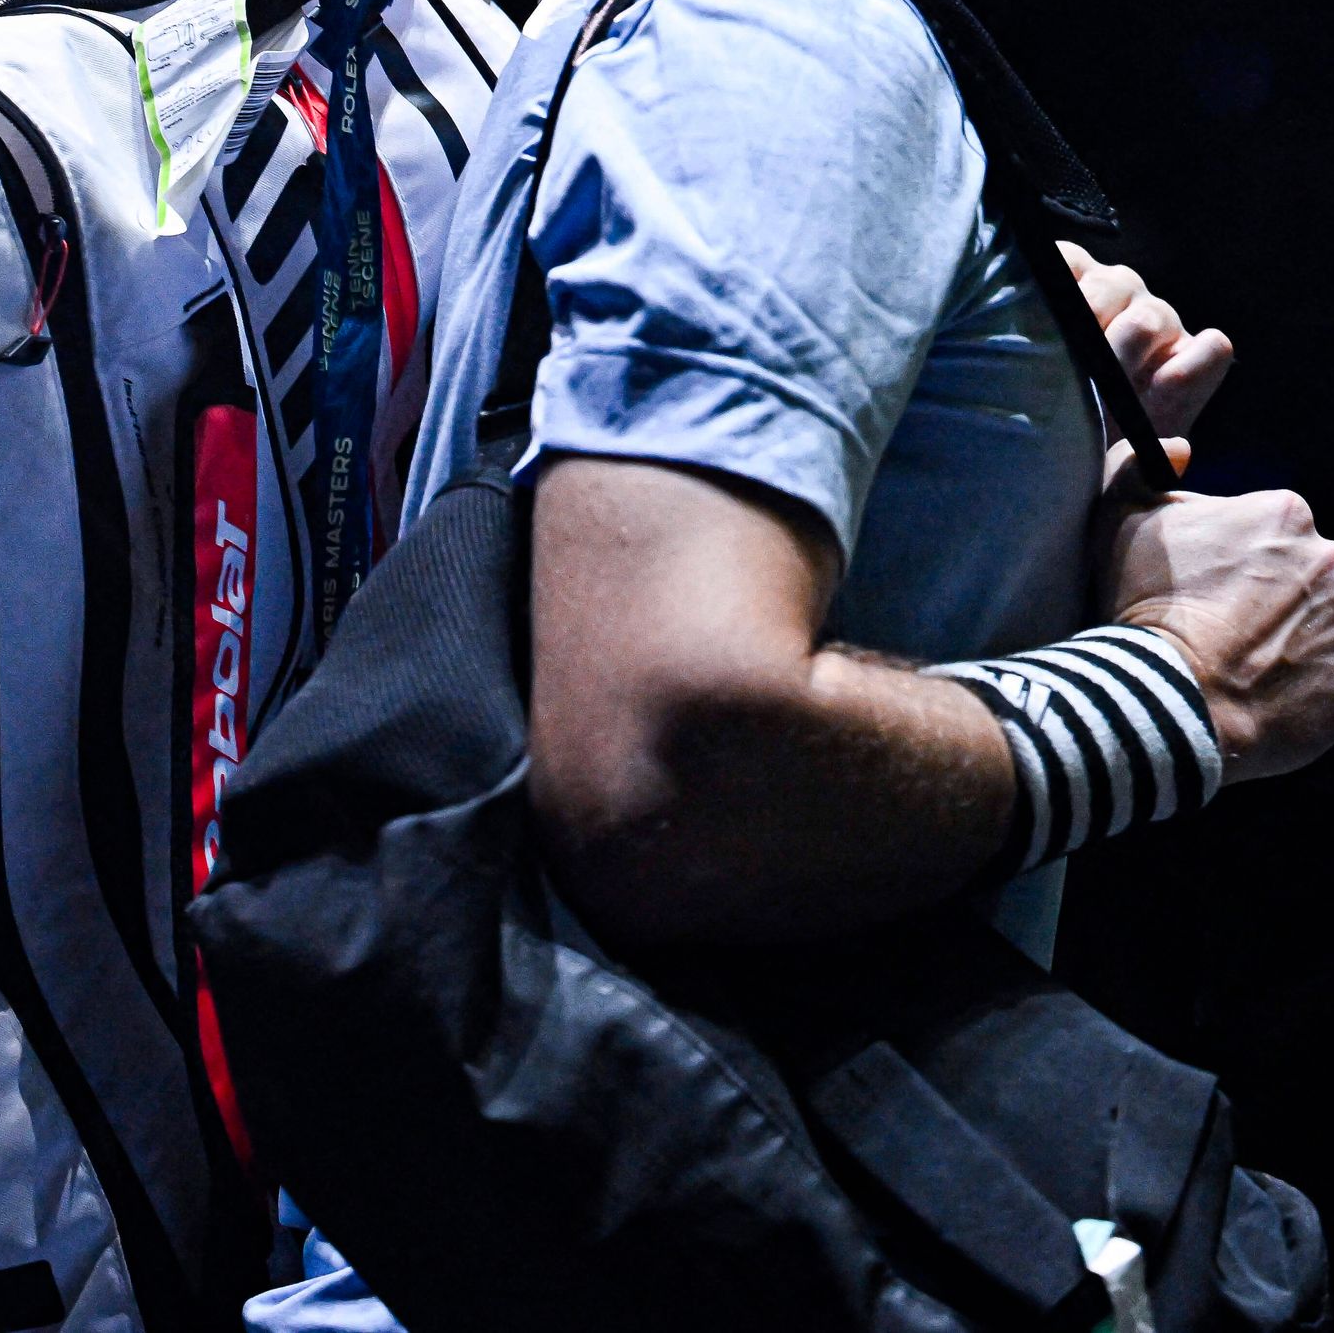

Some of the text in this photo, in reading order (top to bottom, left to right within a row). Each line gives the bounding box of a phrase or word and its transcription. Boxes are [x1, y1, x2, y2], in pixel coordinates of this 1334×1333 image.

[340, 45, 358, 135] ROLEX
[355, 209, 376, 299] SCENE
[322, 435, 354, 642] ARIS MASTERS
